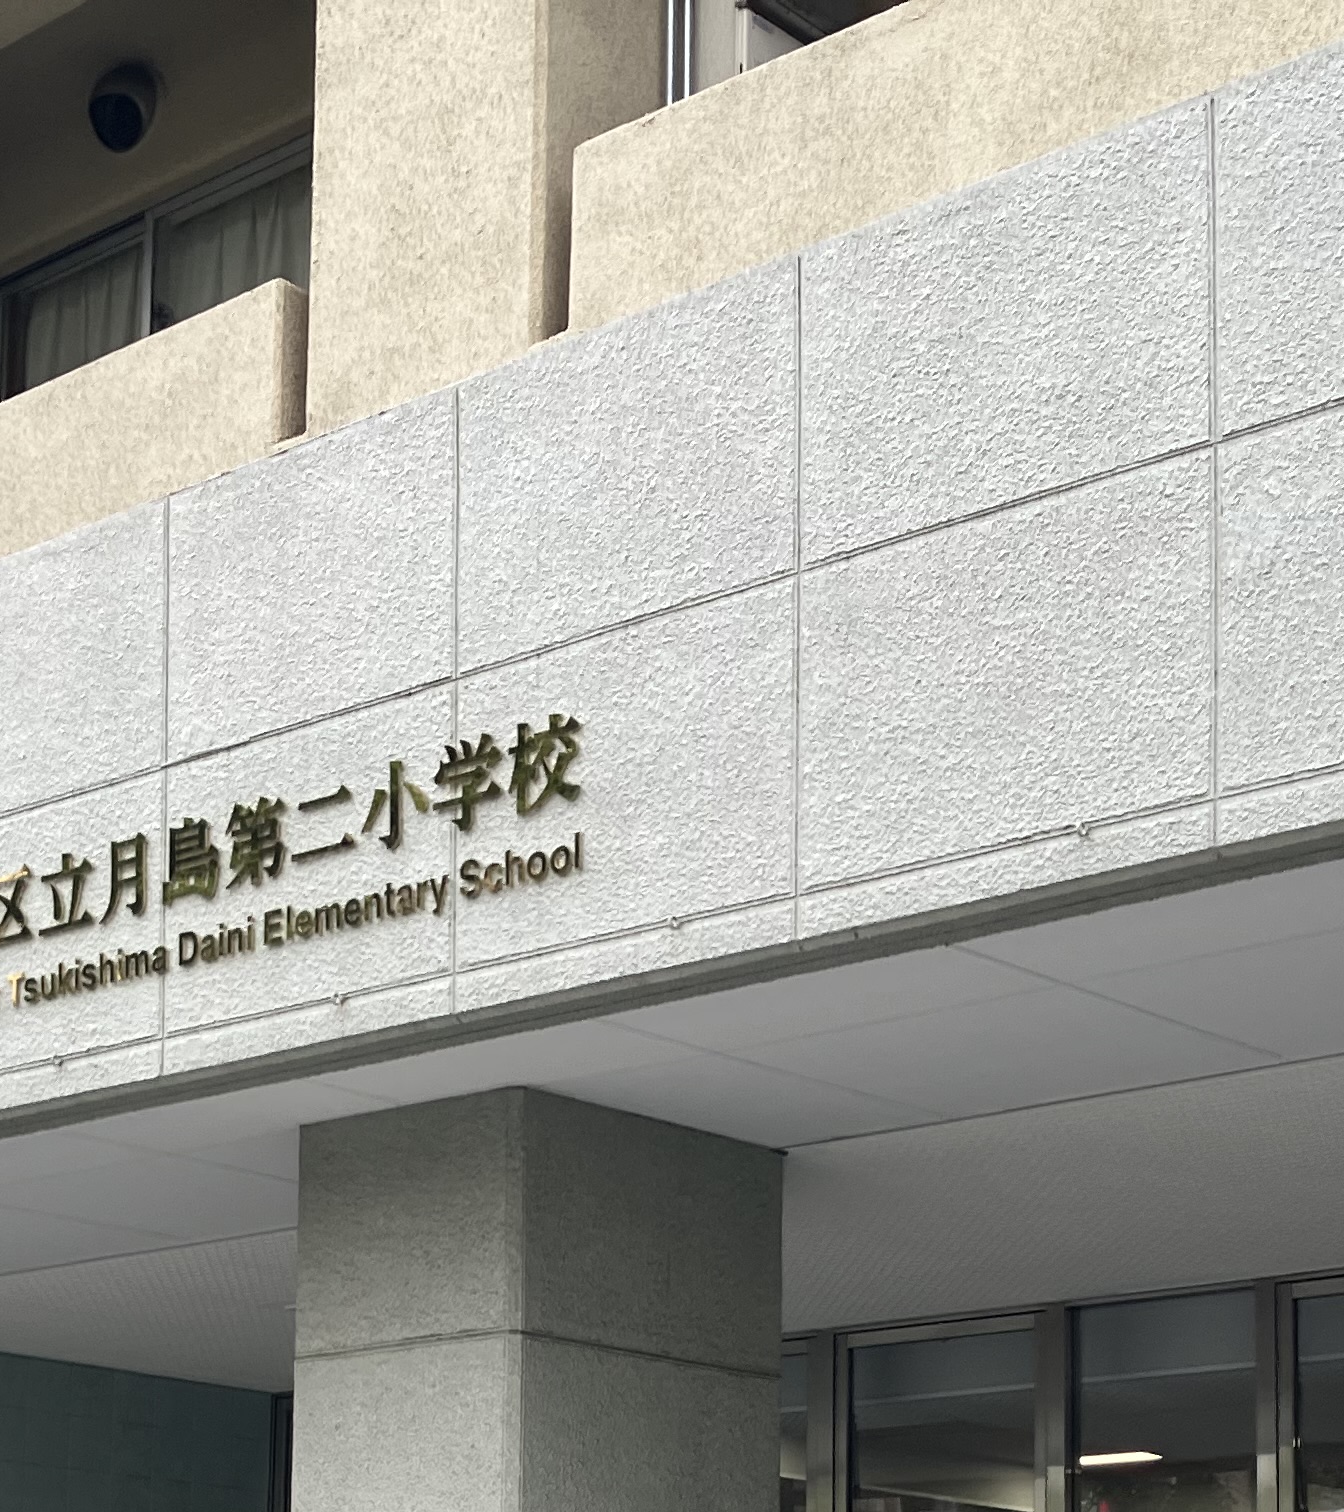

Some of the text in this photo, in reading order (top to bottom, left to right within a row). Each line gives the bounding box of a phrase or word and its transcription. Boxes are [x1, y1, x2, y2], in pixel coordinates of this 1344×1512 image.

[7, 939, 170, 1010] Tsukishima
[177, 911, 256, 969] Daini
[262, 870, 451, 946] Elementary
[458, 831, 584, 899] School
